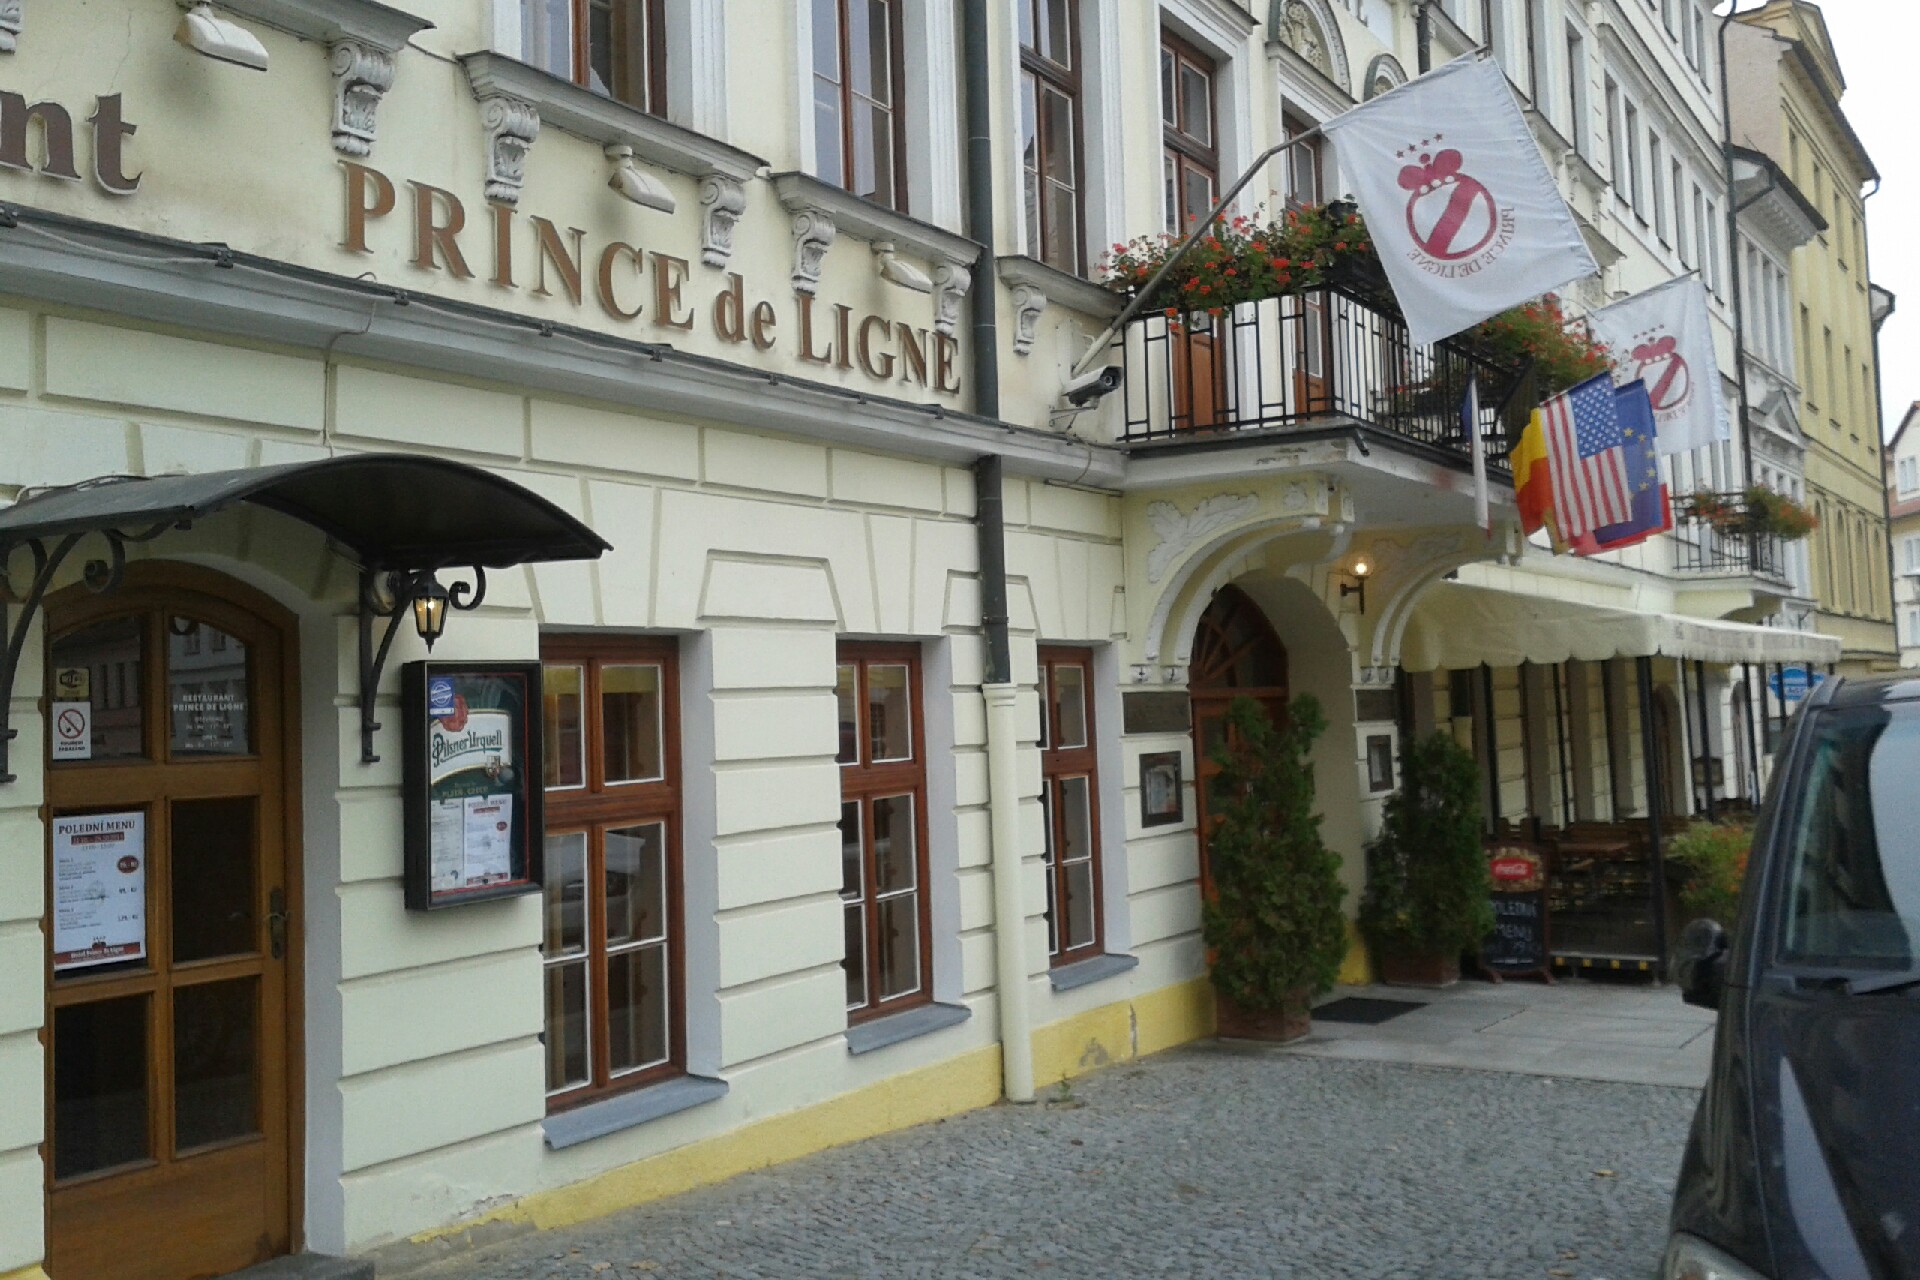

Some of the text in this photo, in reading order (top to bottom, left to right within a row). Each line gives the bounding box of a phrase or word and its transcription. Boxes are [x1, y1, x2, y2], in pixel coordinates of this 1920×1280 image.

[336, 159, 961, 395] PRINCE de LIGNE
[432, 729, 503, 768] Pilsner Urquell
[58, 820, 136, 835] POLEDNÍ MENU
